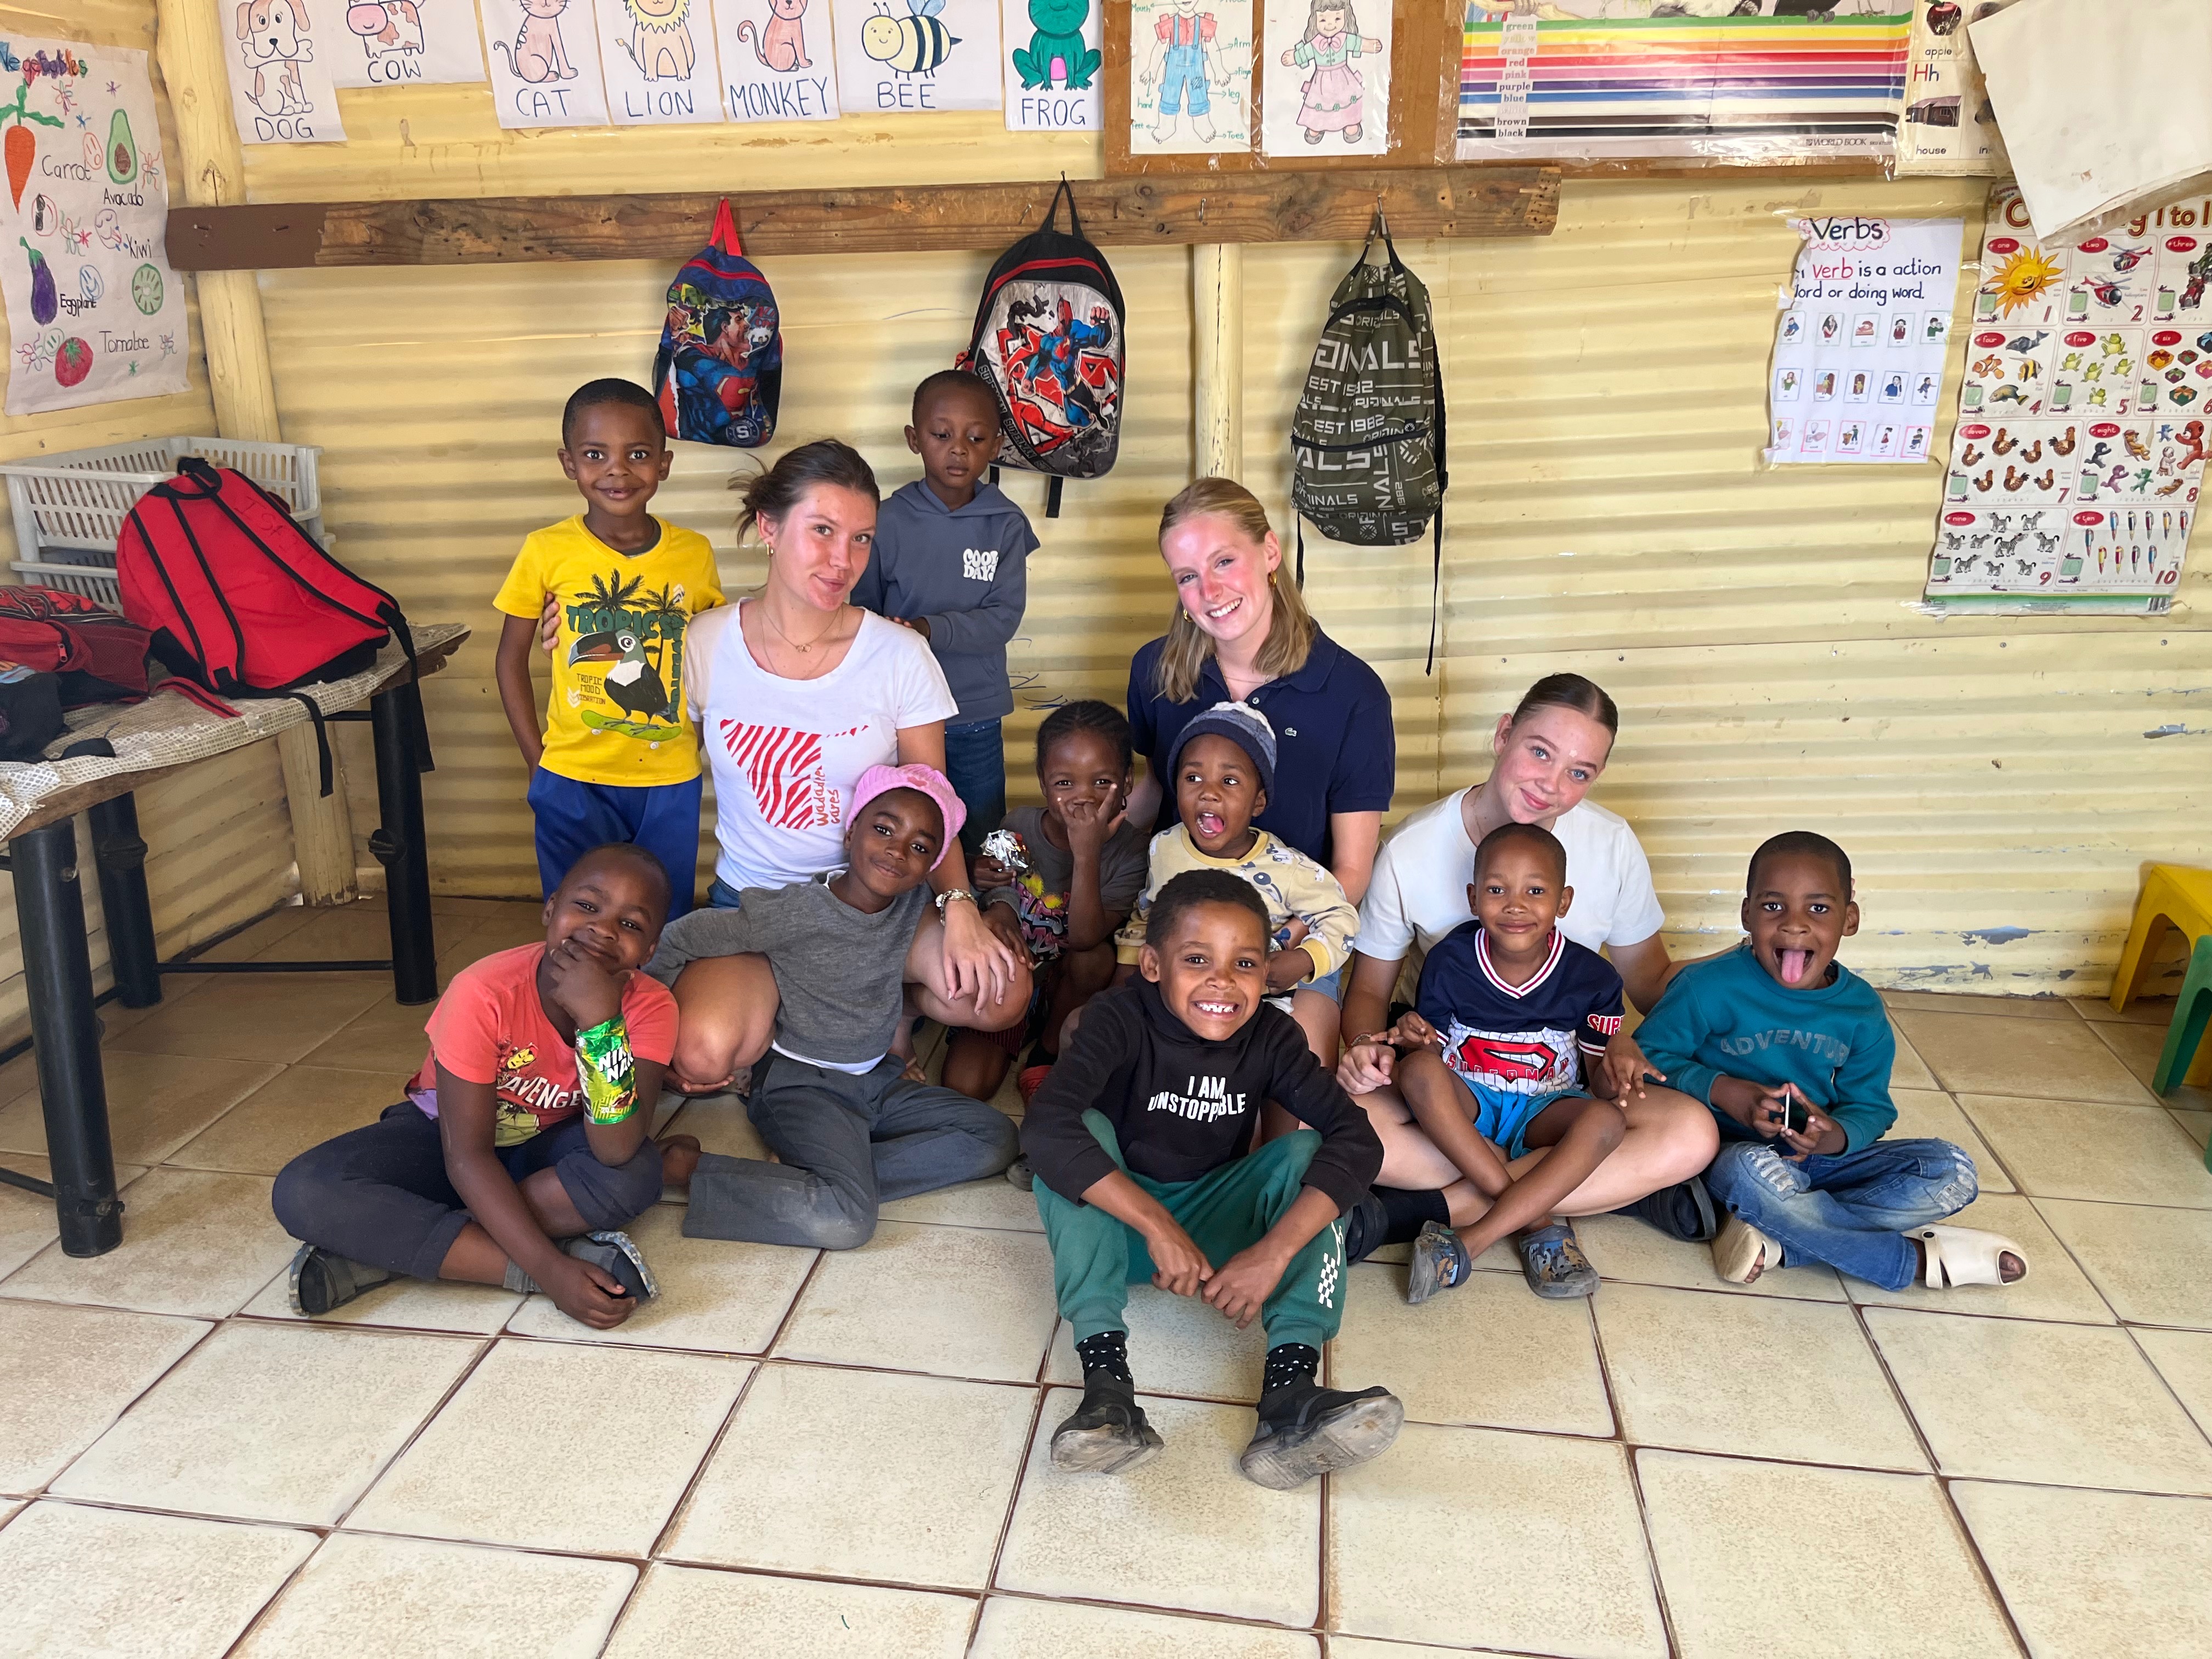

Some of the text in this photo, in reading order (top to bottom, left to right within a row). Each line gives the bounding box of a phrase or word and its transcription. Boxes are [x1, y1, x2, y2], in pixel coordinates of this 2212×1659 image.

[1506, 21, 1534, 32] green
[1234, 37, 1250, 48] Arm
[1501, 46, 1534, 57] orange
[1925, 48, 1952, 60] apple
[1509, 59, 1525, 67] red
[367, 60, 422, 83] COW
[1505, 70, 1527, 81] pink
[1914, 64, 1939, 82] Hh
[878, 81, 936, 109] BEE
[1499, 82, 1531, 93] purple
[516, 88, 571, 117] CAT
[624, 90, 695, 118] LION
[730, 76, 829, 119] MONKEY
[1137, 97, 1153, 109] hand
[1228, 88, 1240, 104] leg
[1504, 94, 1524, 103] blue
[1021, 98, 1087, 126] FROG
[255, 117, 314, 142] DOG
[1497, 117, 1526, 126] brown
[1227, 131, 1244, 139] Toes
[1498, 128, 1523, 137] black
[1916, 145, 1946, 155] house
[1979, 146, 1990, 154] in
[42, 155, 91, 180] Carrot
[104, 183, 144, 206] Avocado
[2170, 206, 2196, 226] to
[2202, 200, 2212, 226] 1
[1809, 216, 1883, 240] Verbs
[126, 233, 152, 259] Kiwi
[1812, 257, 1853, 279] verb
[1859, 260, 1871, 276] is
[1876, 266, 1886, 275] a
[1893, 258, 1942, 276] action
[1828, 288, 1843, 298] or
[1849, 284, 1887, 306] doing
[1892, 281, 1925, 300] word.
[60, 294, 97, 317] Eggplant
[2131, 304, 2143, 321] 2
[2044, 305, 2052, 323] 1
[1982, 334, 1997, 343] four
[2072, 335, 2087, 343] five
[1308, 375, 1341, 393] EST
[2029, 399, 2042, 415] 4
[2116, 399, 2130, 415] 5
[1314, 414, 1385, 435] EST 1982
[2097, 426, 2117, 437] eight
[1003, 417, 1037, 459] SUPERMAN
[2058, 487, 2070, 503] 7
[2186, 487, 2198, 503] 8
[2040, 572, 2052, 585] 9
[2155, 570, 2177, 584] 10
[577, 673, 602, 685] TROPIC
[580, 684, 600, 695] MOOD
[827, 789, 841, 824] cares
[1187, 1075, 1226, 1099] I AM
[1147, 1091, 1246, 1123] UNSTOPPBLE
